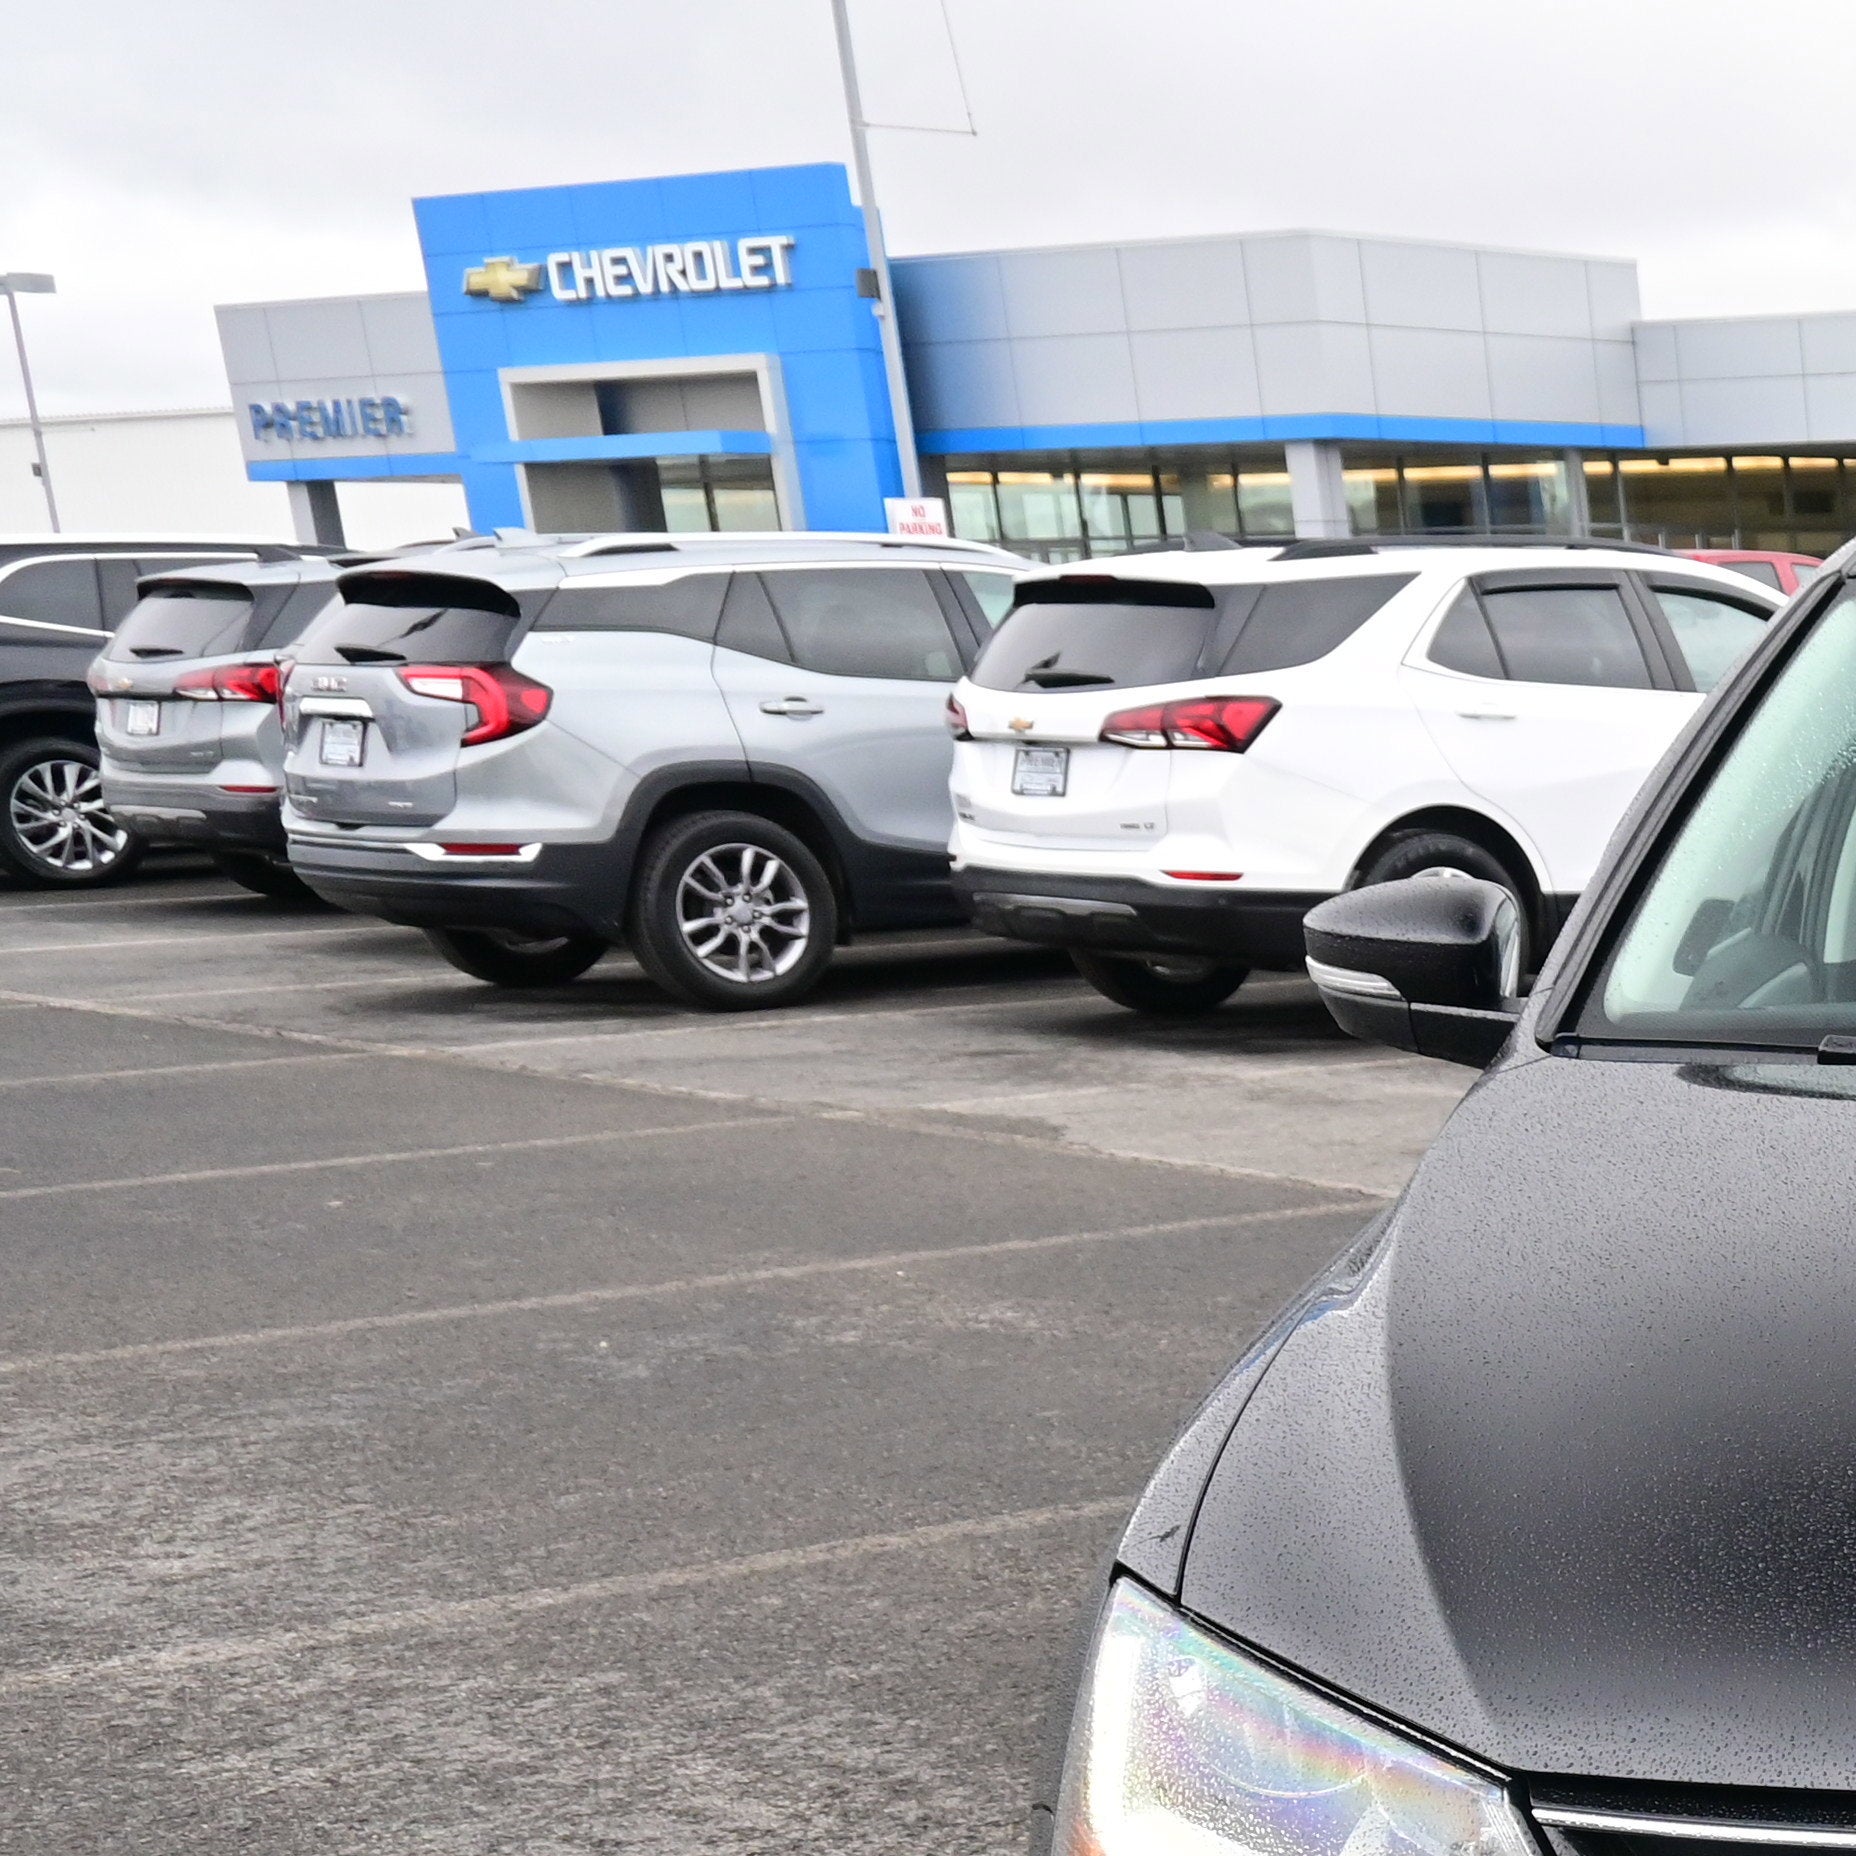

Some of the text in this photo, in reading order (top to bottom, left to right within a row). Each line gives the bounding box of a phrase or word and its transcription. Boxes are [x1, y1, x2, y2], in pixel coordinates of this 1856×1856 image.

[547, 236, 794, 301] CHEVROLET
[249, 396, 411, 442] PREMIER
[911, 505, 926, 518] NO
[899, 522, 943, 535] PARKING
